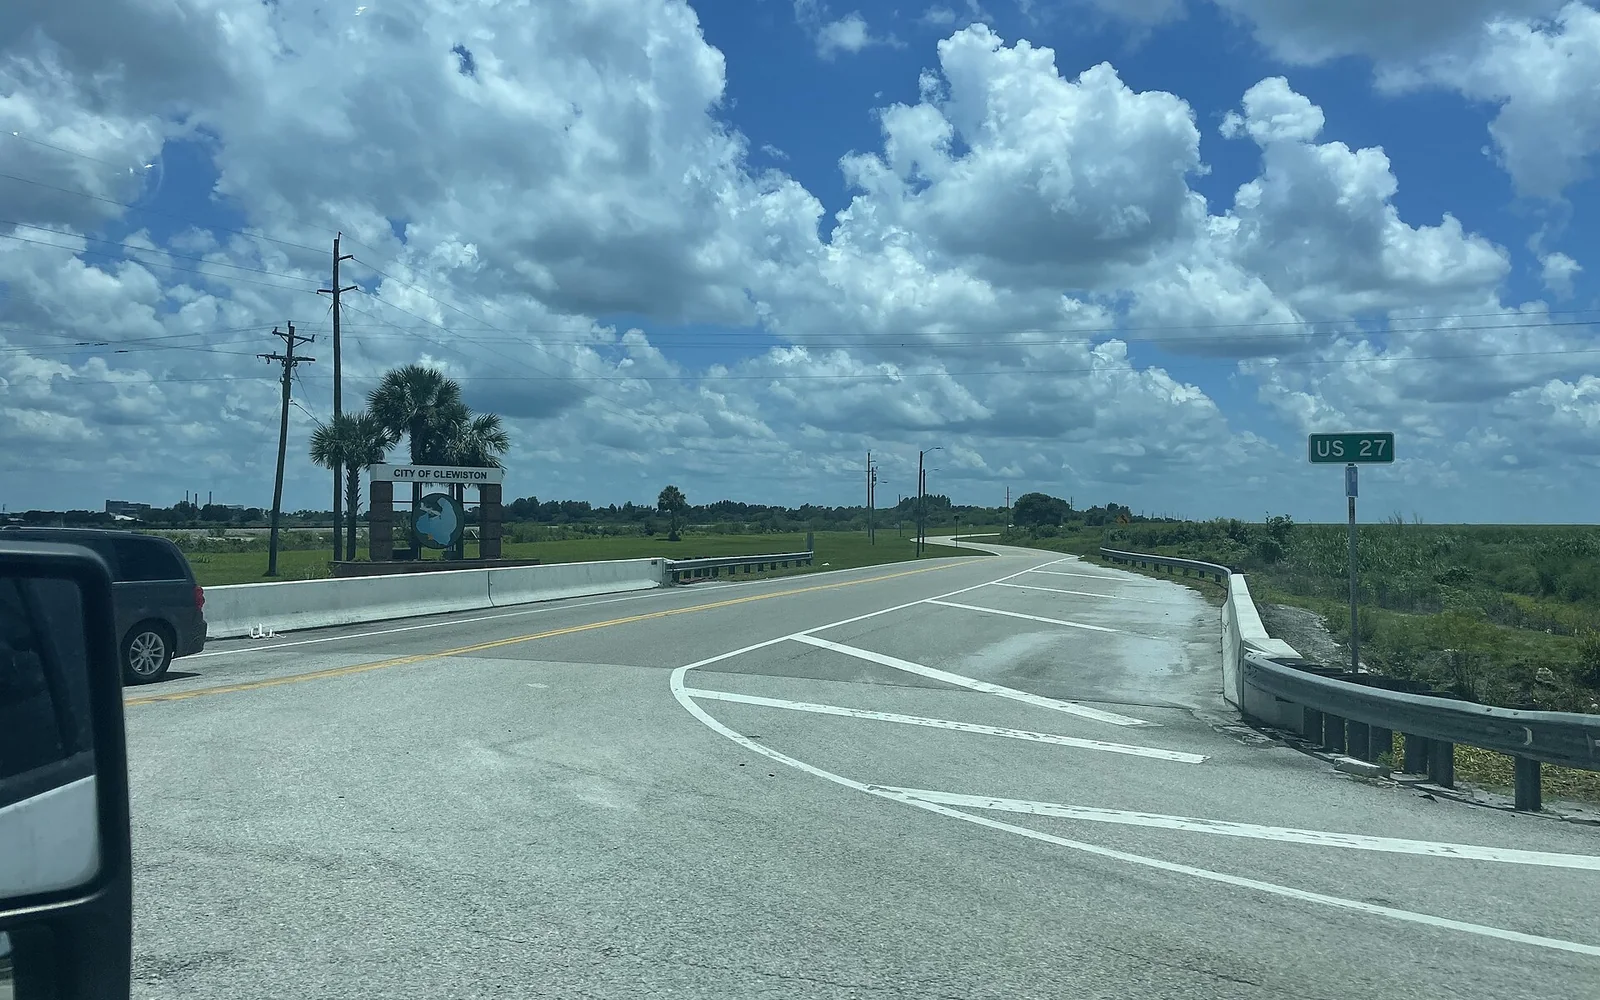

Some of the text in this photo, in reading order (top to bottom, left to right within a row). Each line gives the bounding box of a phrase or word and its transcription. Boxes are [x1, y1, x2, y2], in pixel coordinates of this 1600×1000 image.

[1317, 439, 1387, 457] US 27
[393, 469, 488, 479] CITY OF CLEWISTON
